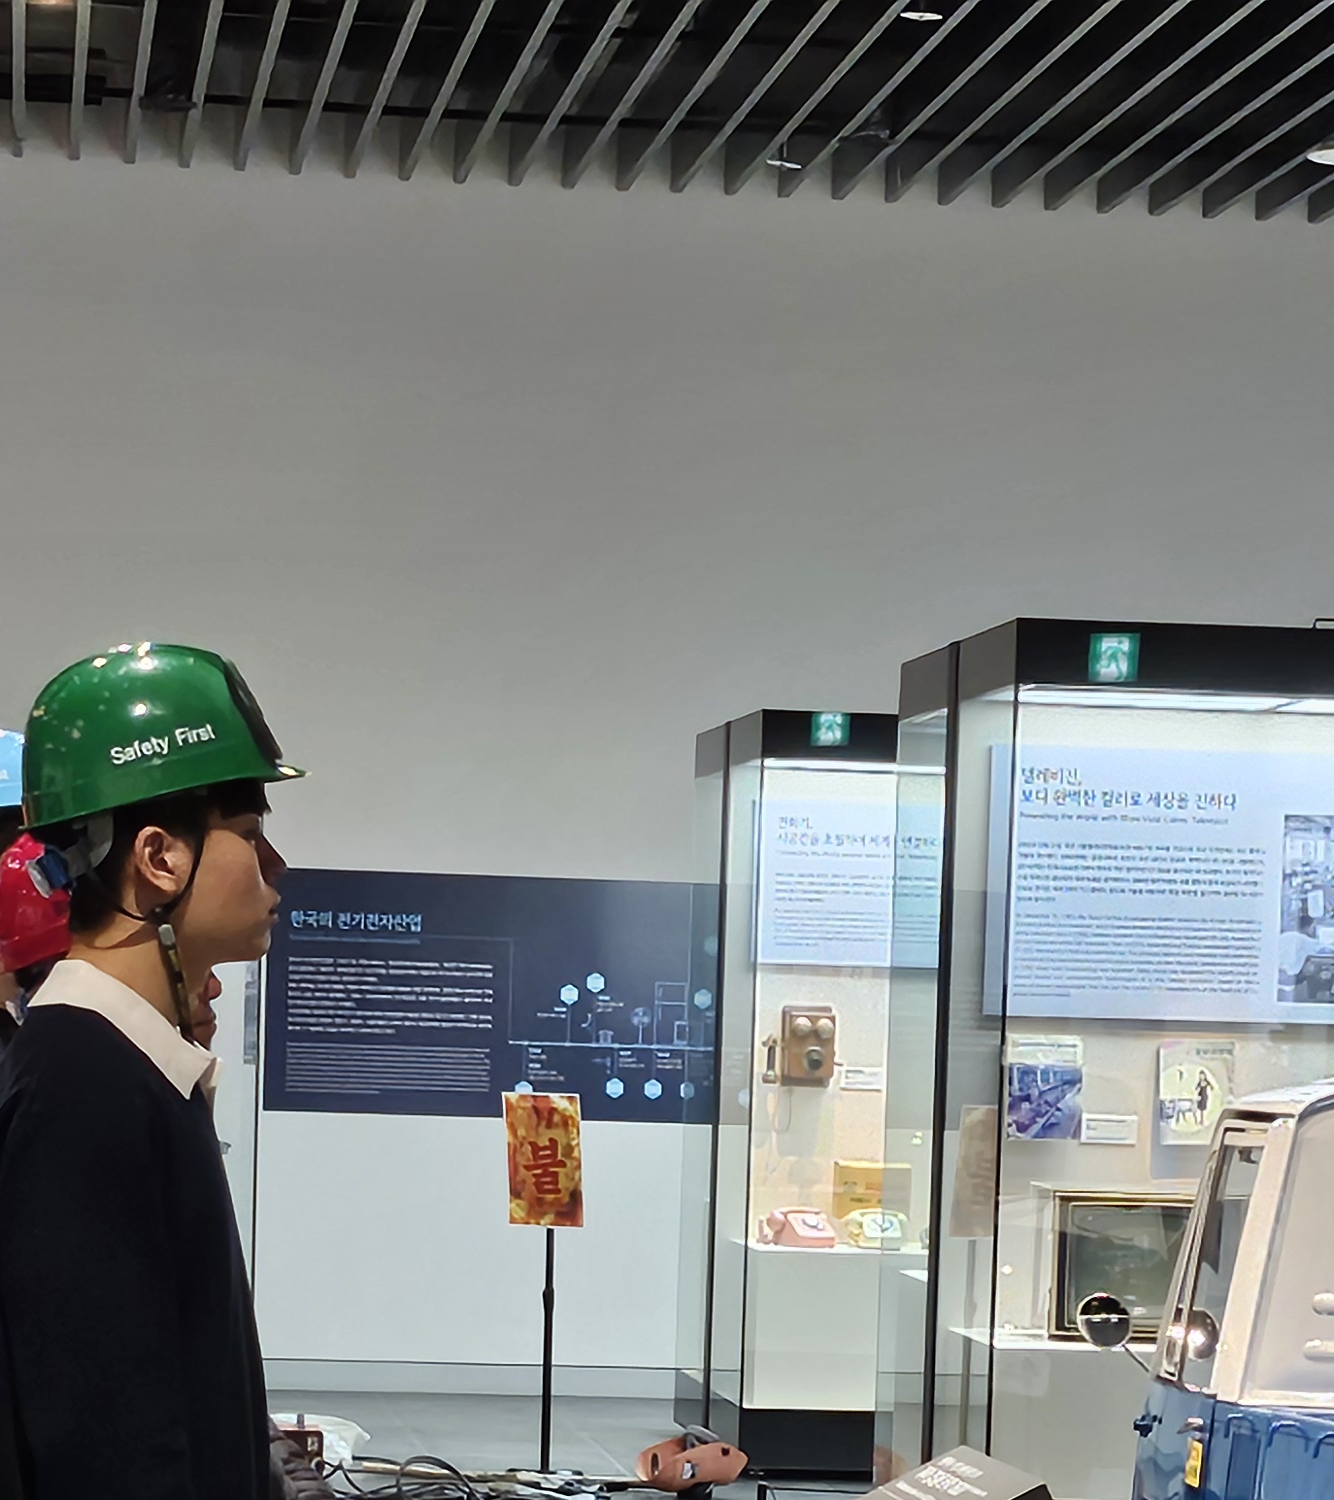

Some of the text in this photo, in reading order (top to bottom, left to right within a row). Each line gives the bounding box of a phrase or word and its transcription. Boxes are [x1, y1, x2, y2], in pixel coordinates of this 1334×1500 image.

[110, 723, 216, 765] Safety First
[337, 912, 422, 933] 전기전자산업
[523, 1137, 568, 1197] 불
